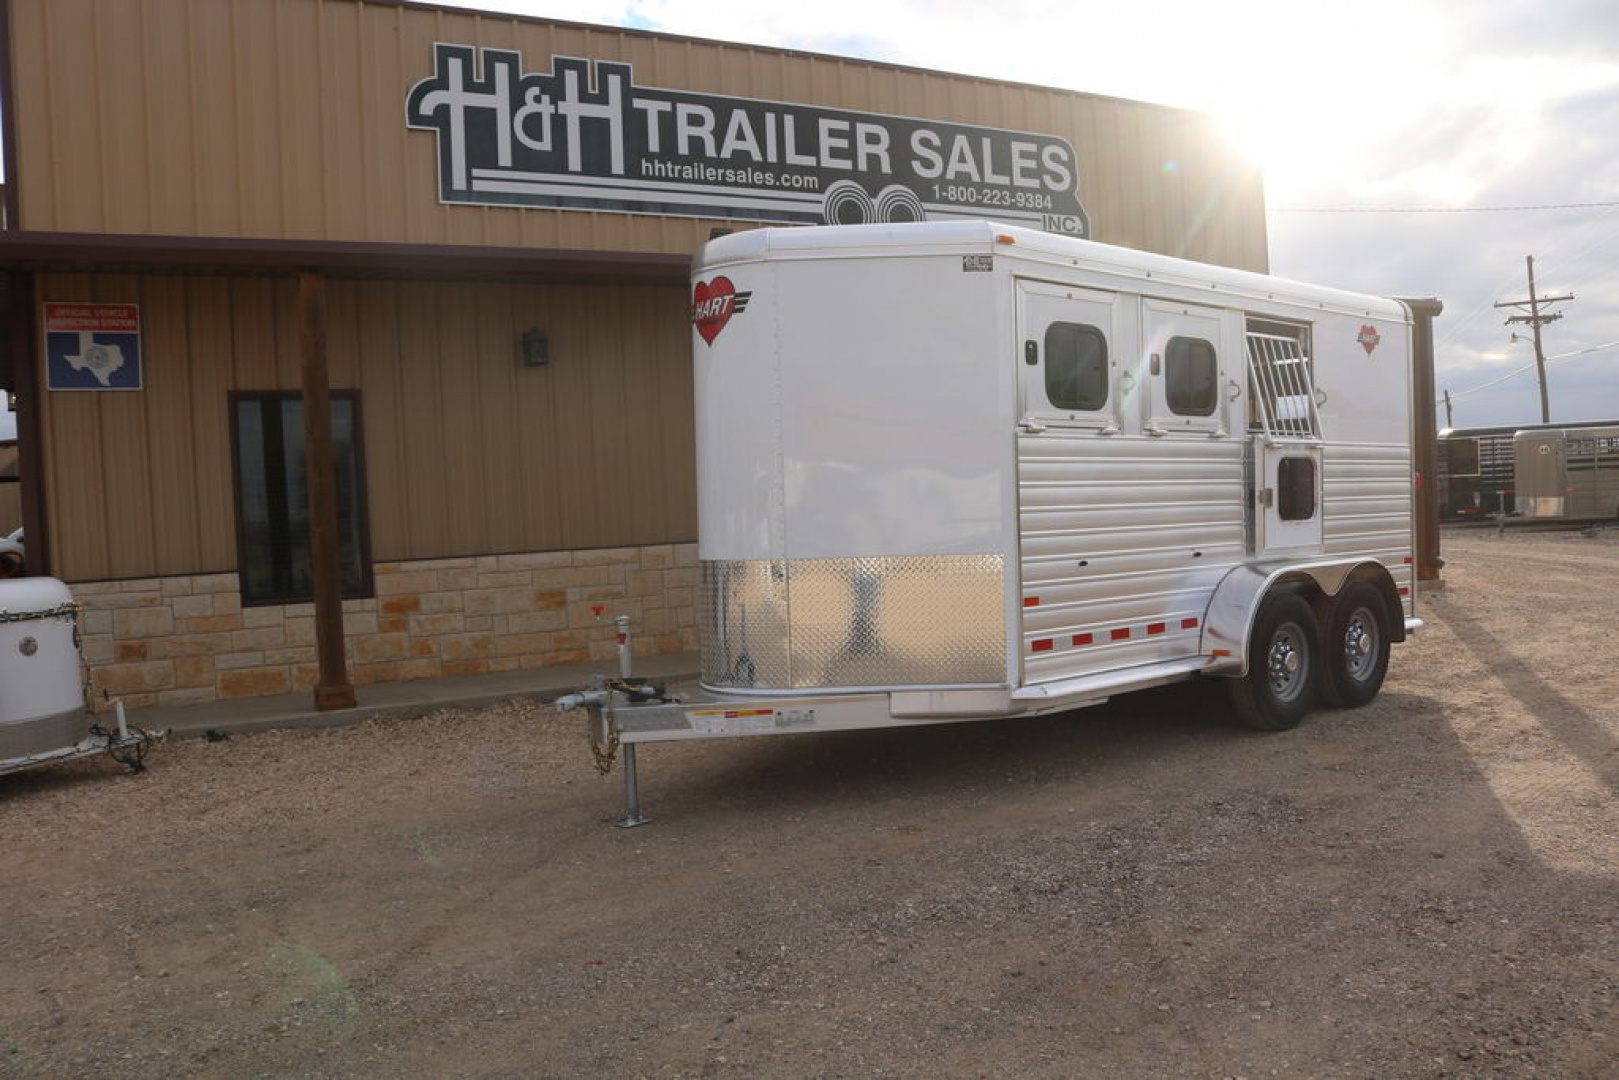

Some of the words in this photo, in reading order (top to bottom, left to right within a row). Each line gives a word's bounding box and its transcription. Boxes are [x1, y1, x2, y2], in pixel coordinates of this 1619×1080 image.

[632, 98, 892, 174] TRAILER
[910, 129, 1071, 191] SALES
[641, 158, 819, 189] hhtrailersales.com
[932, 184, 1052, 209] 1-800-223-9384
[1042, 214, 1081, 233] INC.
[695, 294, 734, 321] HART
